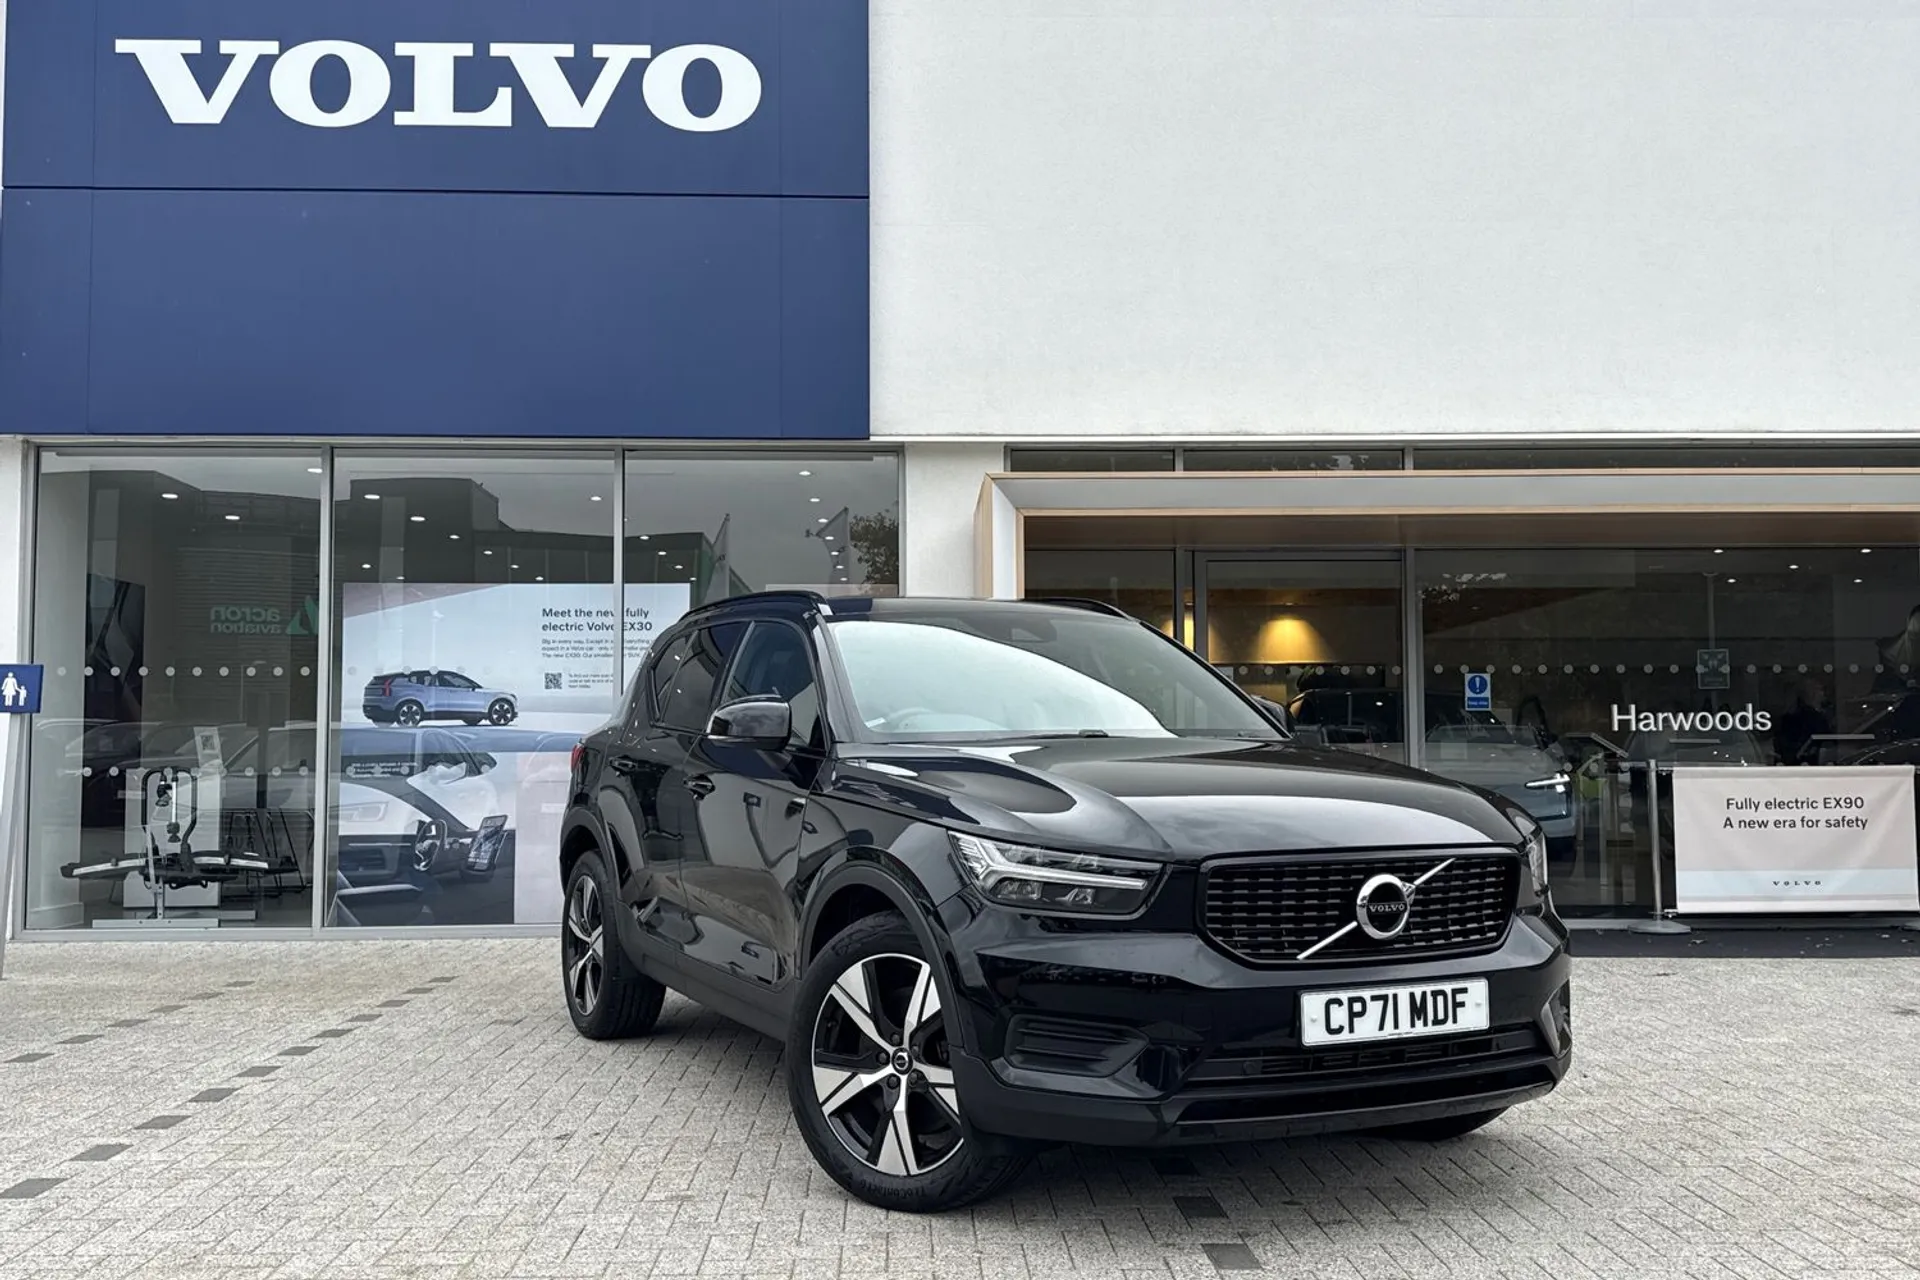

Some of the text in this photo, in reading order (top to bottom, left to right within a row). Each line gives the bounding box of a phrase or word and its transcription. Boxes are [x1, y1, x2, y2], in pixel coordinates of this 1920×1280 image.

[115, 39, 762, 132] VOLVO
[542, 608, 571, 617] Meet
[575, 608, 593, 617] the
[625, 608, 649, 619] fully
[541, 622, 584, 631] electric
[622, 621, 653, 631] EX30
[1611, 703, 1772, 731] Harwoods
[1726, 796, 1865, 812] Fully electric EX90
[1723, 816, 1868, 830] A new era for safety
[1369, 903, 1406, 912] VOLVO
[1325, 987, 1468, 1035] CP71 MDF
